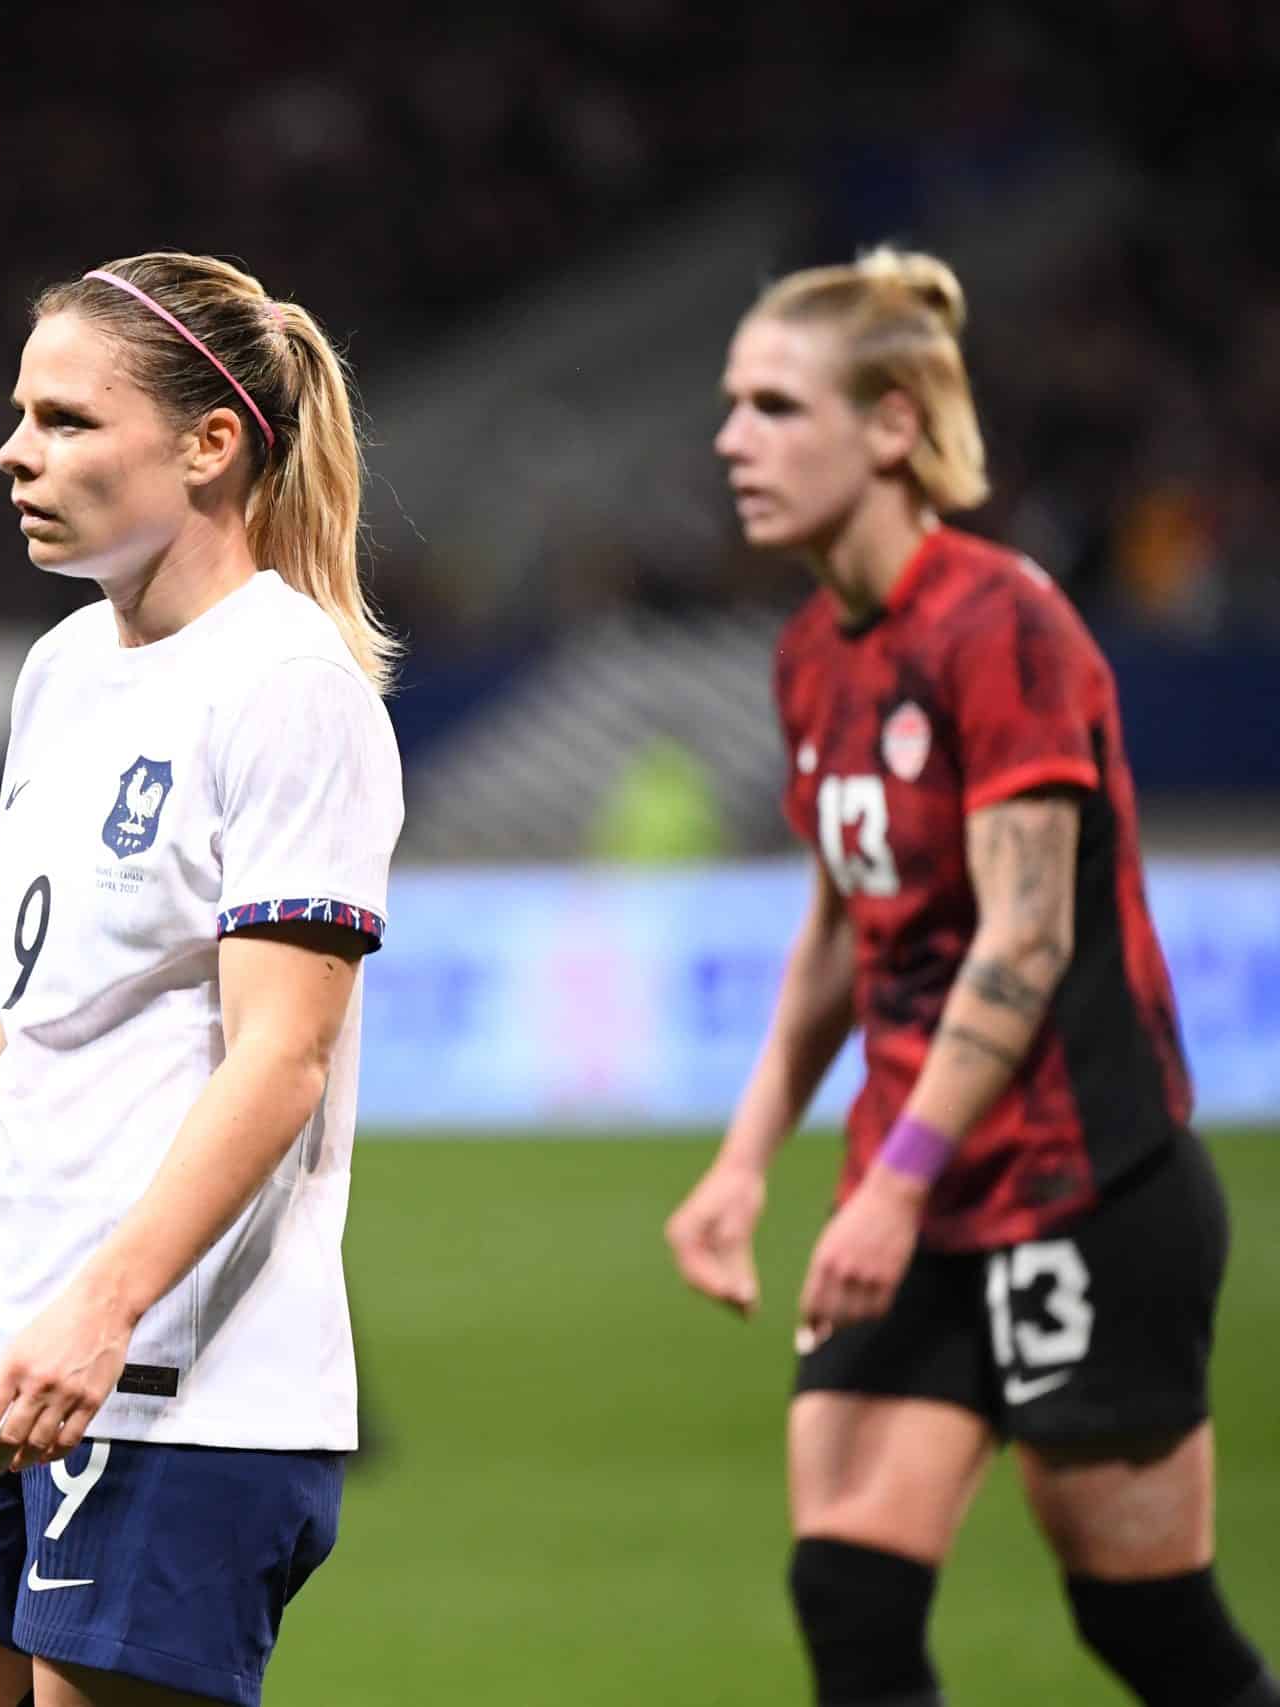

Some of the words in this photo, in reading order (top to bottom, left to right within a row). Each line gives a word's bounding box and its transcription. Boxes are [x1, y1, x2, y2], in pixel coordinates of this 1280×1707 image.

[818, 775, 899, 896] 13
[2, 874, 50, 1009] 9
[987, 1239, 1093, 1367] 13
